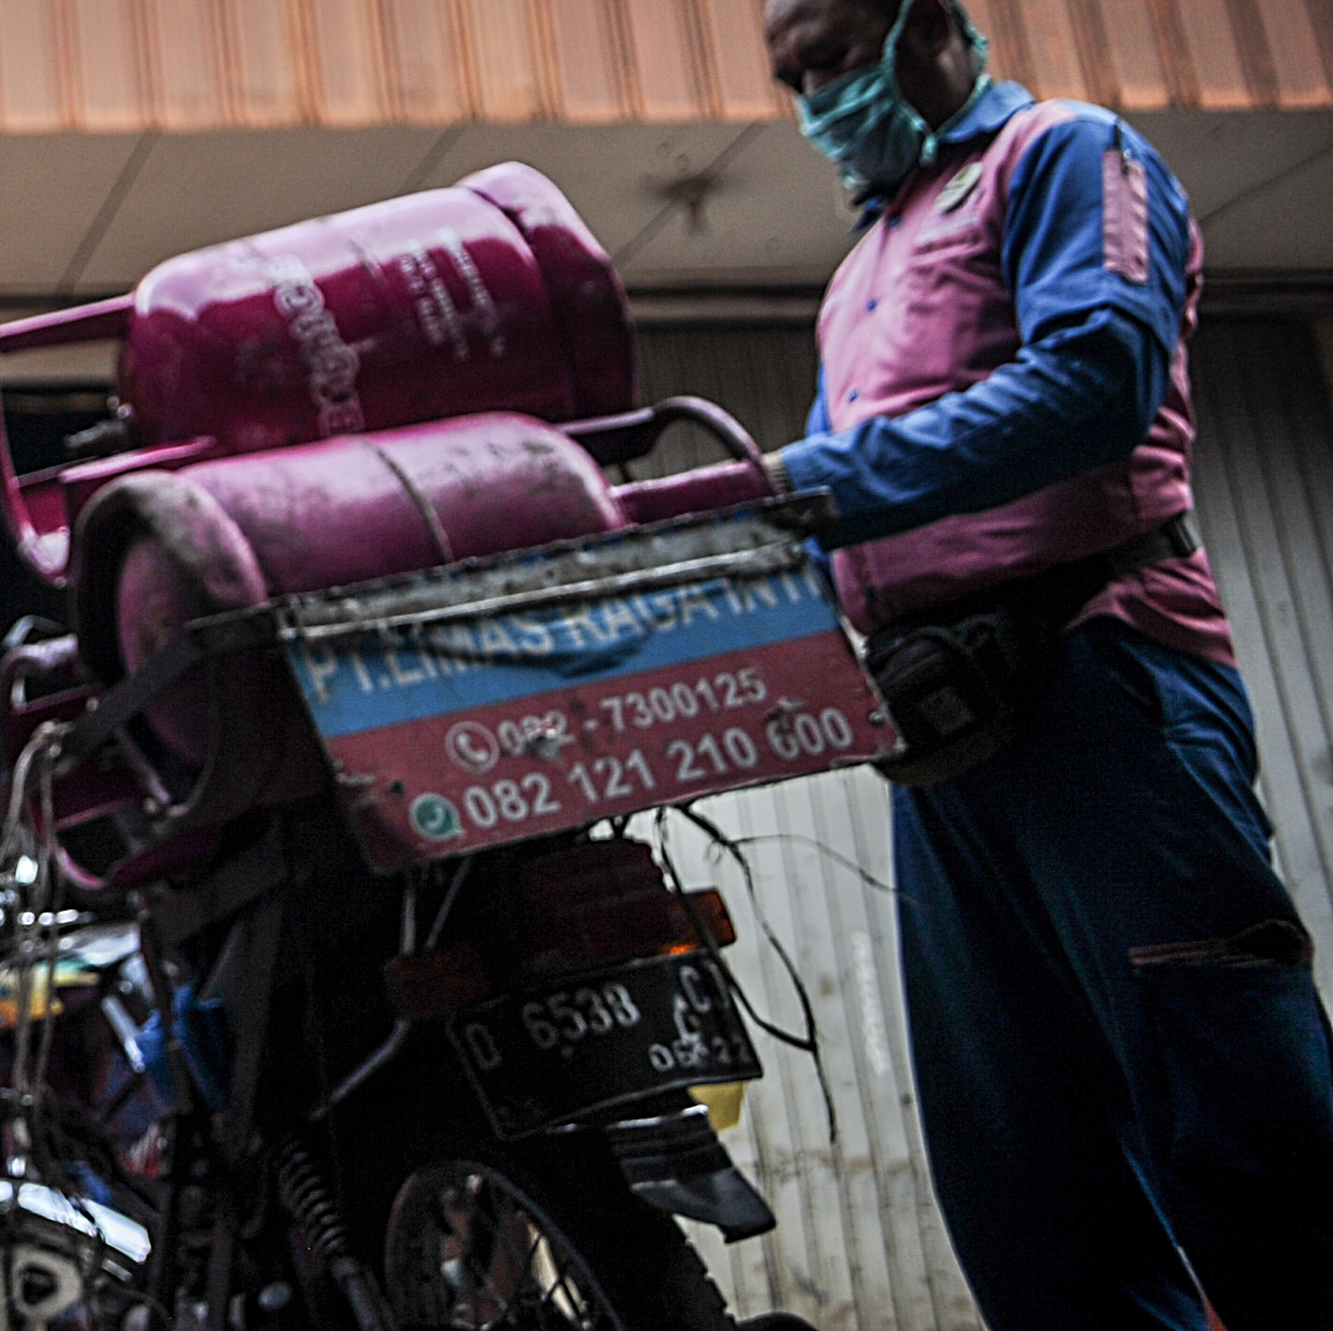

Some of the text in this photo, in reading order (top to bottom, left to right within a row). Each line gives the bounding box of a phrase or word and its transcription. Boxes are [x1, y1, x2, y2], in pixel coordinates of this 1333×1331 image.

[560, 582, 720, 649] RAGA
[600, 667, 768, 733] 7300125
[463, 708, 853, 828] 082 121 210 600
